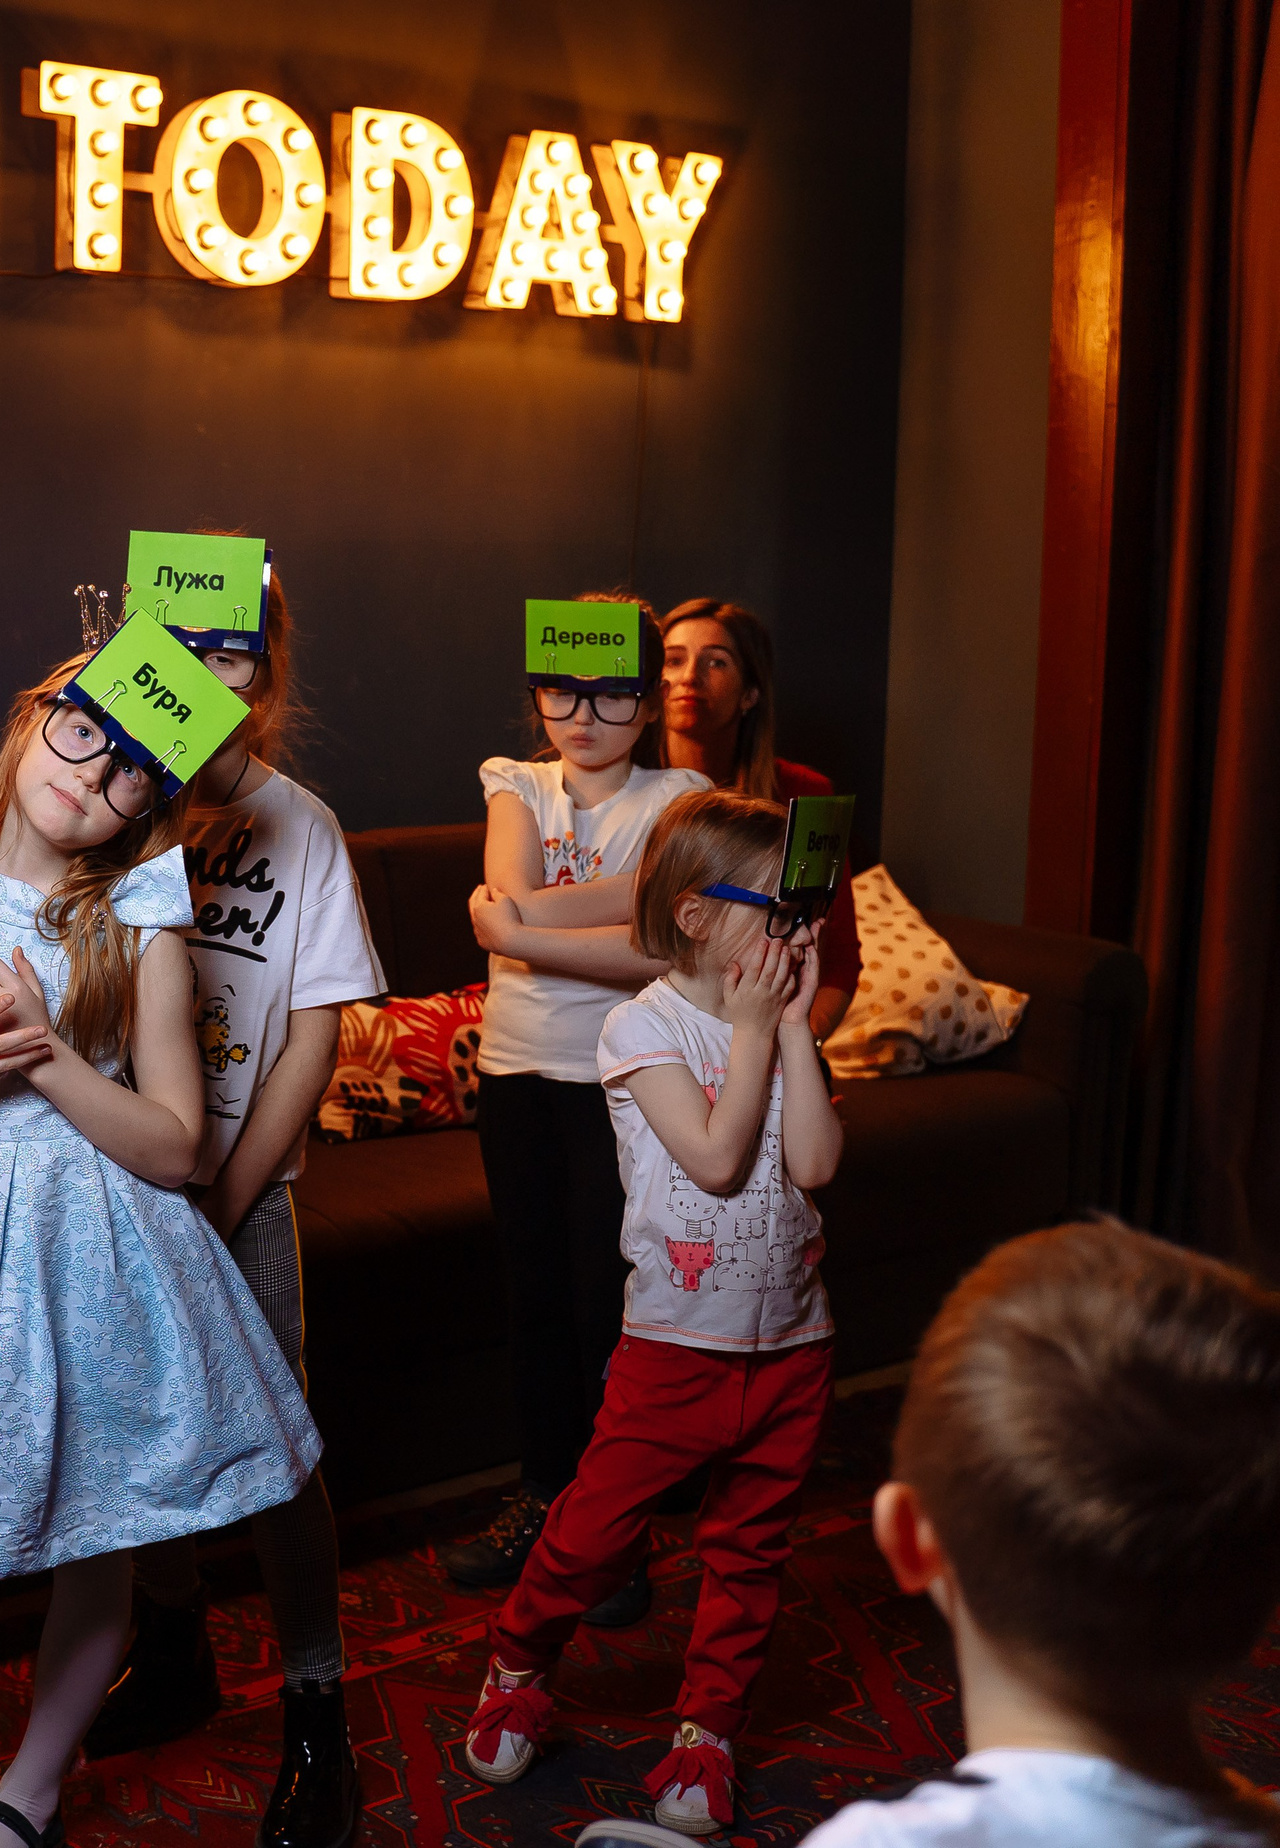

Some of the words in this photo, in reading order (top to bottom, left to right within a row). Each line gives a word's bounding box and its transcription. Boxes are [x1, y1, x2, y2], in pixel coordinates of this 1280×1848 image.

[28, 60, 724, 324] TODAY
[153, 565, 225, 595] Лужа
[540, 626, 626, 650] Дерево
[131, 661, 193, 724] Буря
[185, 828, 275, 893] nds
[192, 890, 286, 946] er!
